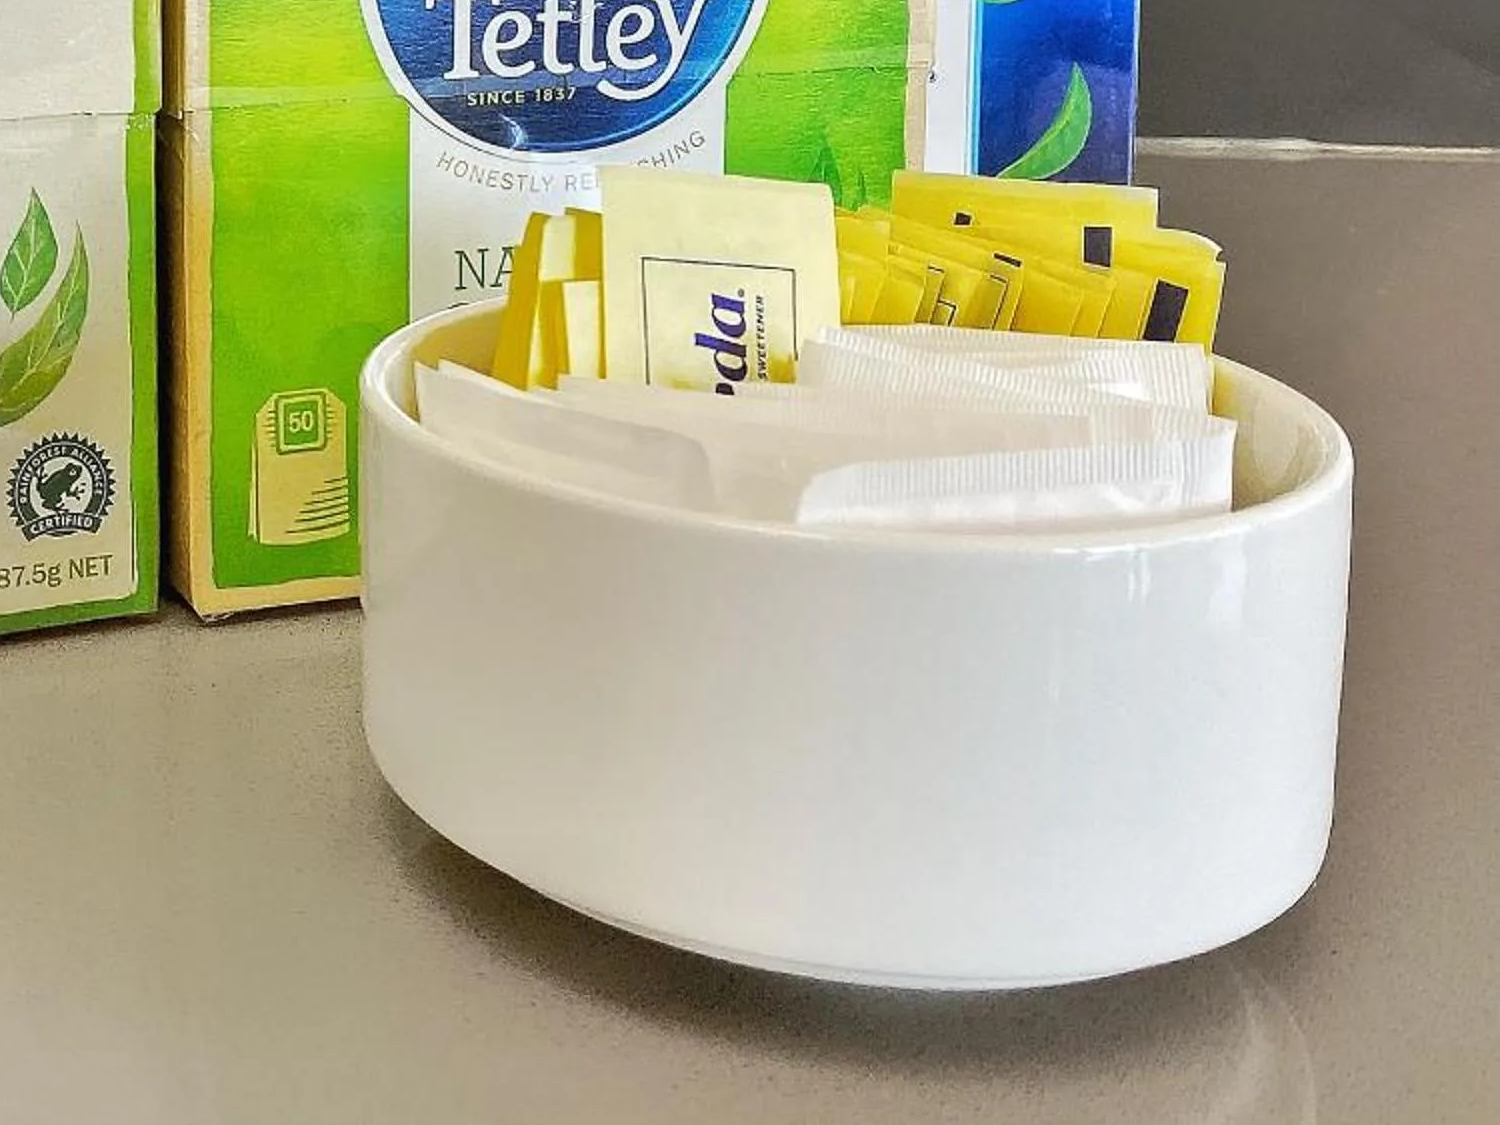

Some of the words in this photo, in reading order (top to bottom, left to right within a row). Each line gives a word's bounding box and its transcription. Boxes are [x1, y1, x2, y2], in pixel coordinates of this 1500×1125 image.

[466, 89, 525, 106] SINCE
[535, 86, 577, 102] 1837
[435, 150, 555, 193] HONESTLY
[755, 295, 769, 382] SWEETENER
[289, 410, 314, 433] 50
[30, 513, 94, 534] CERTIFIED
[68, 554, 113, 580] NET
